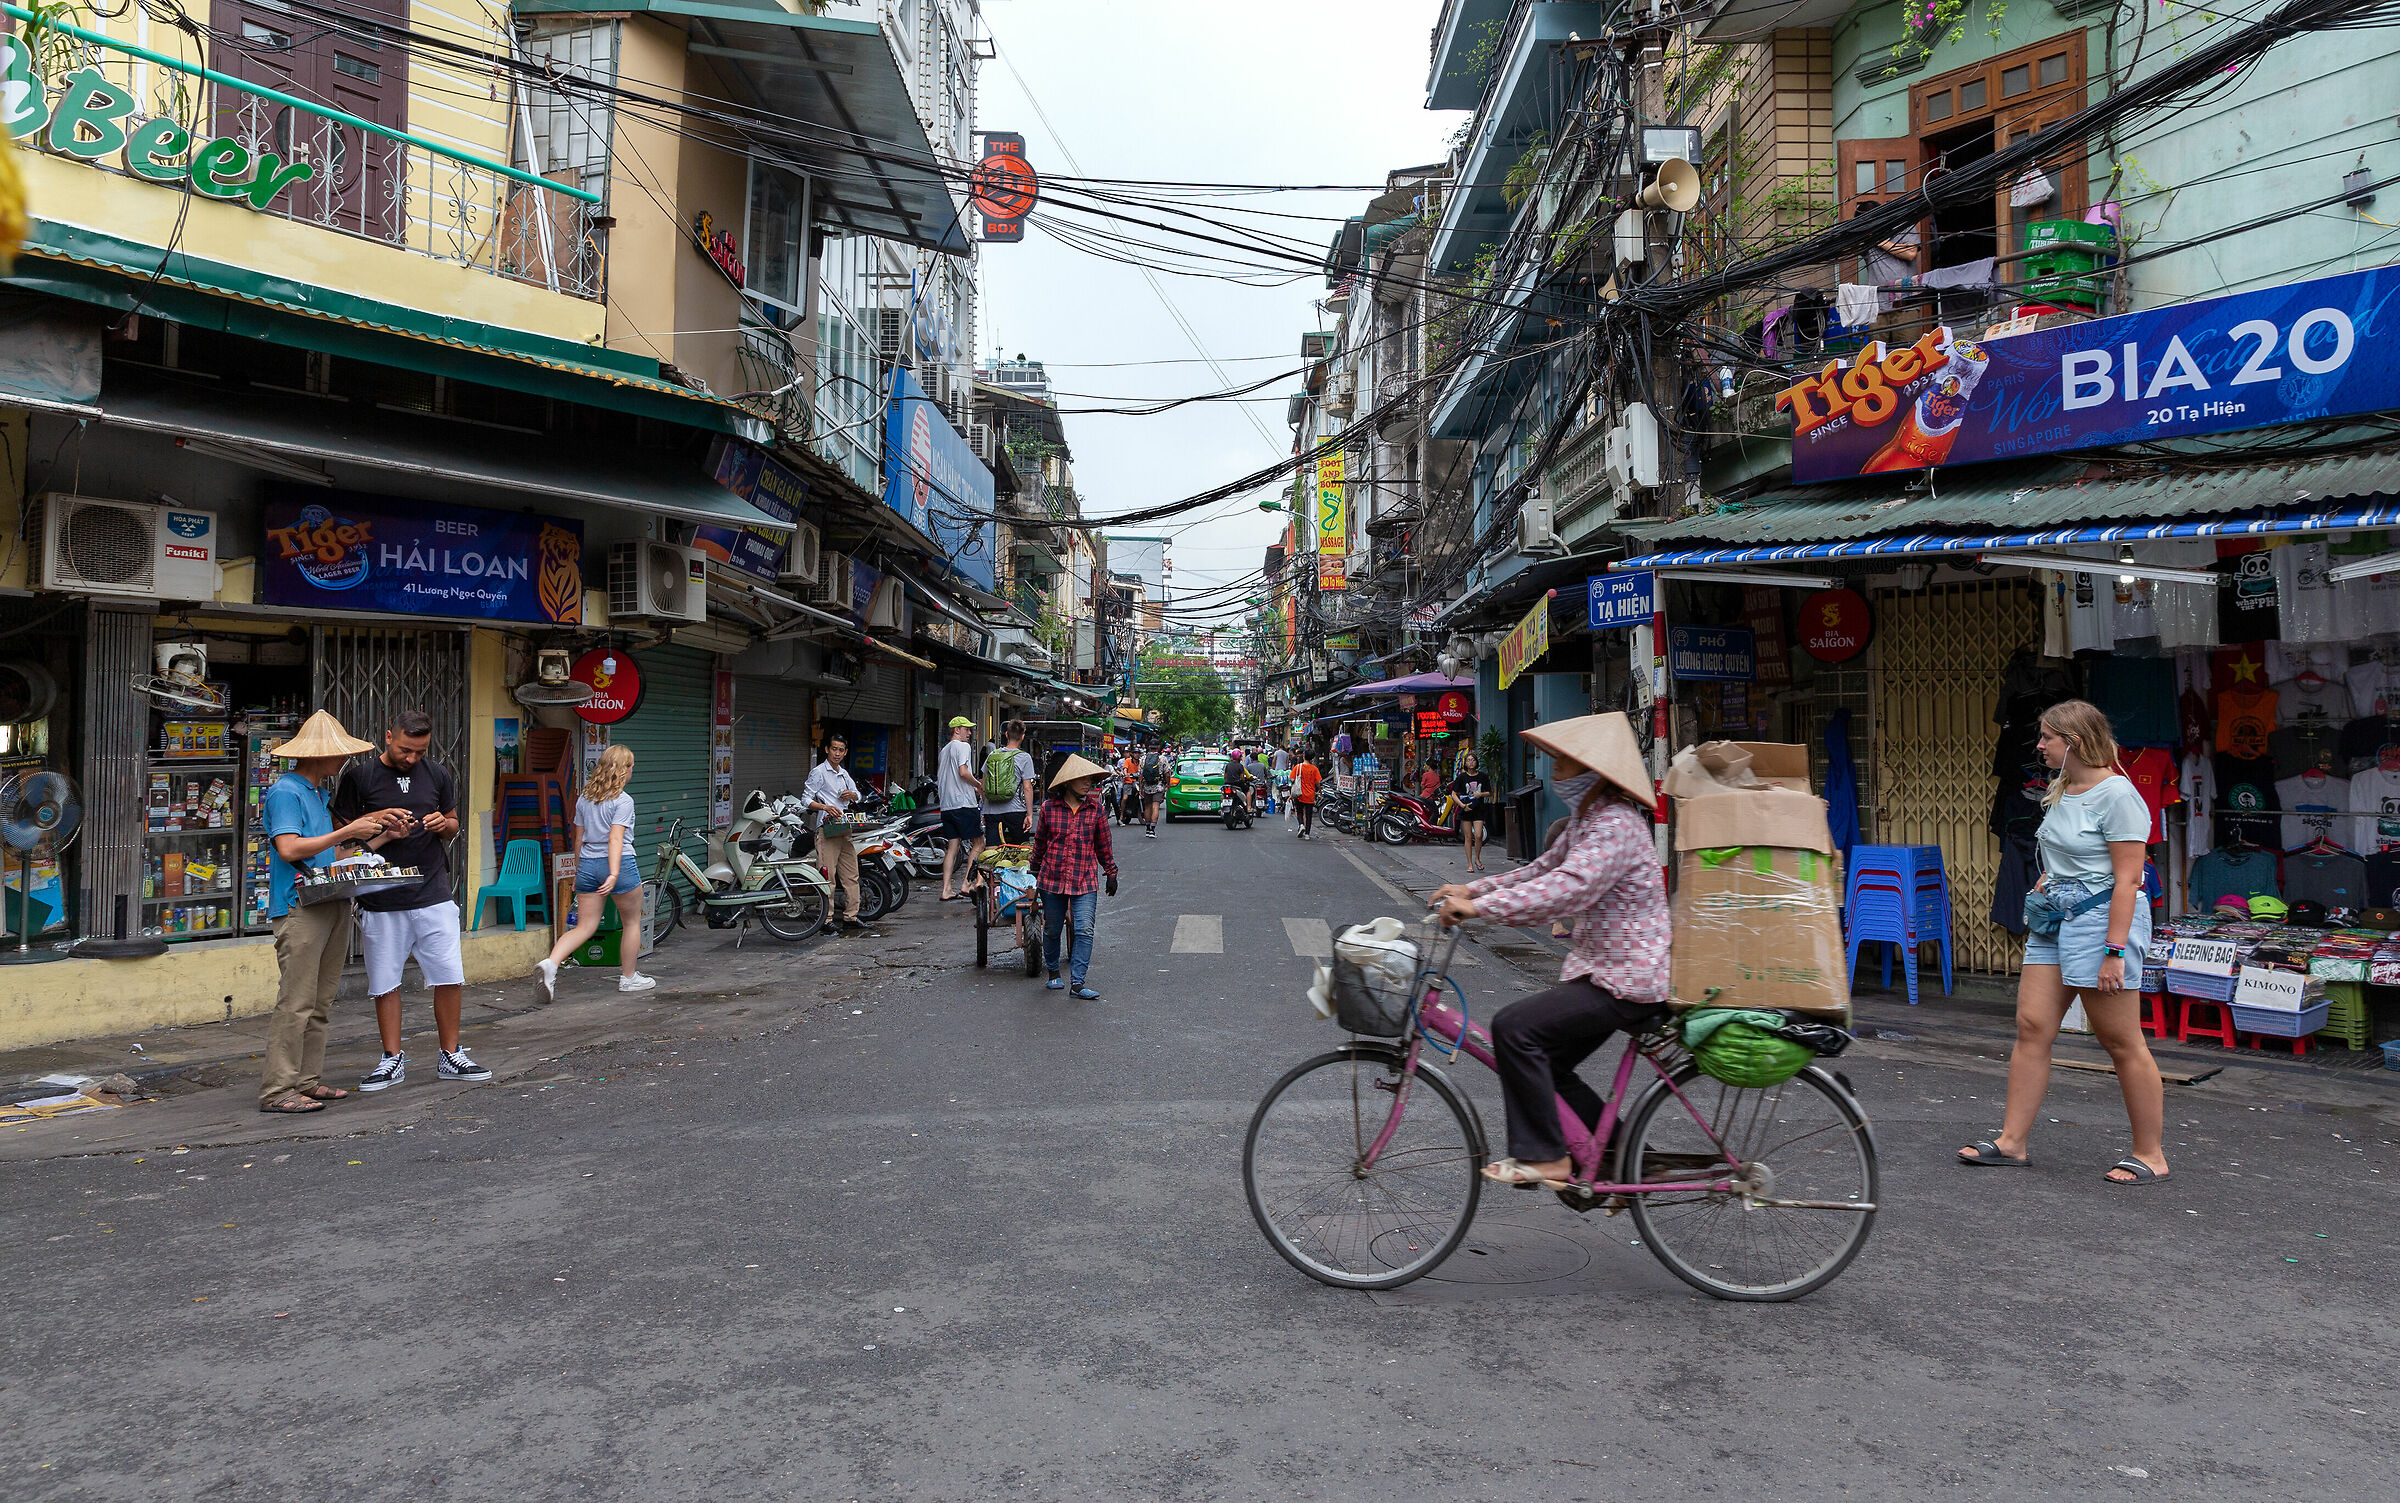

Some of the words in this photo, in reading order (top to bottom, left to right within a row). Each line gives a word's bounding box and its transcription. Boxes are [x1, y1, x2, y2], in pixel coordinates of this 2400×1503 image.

[47, 66, 314, 212] Beer
[990, 140, 1019, 153] THE
[987, 222, 1018, 234] BOX
[2061, 334, 2212, 412] BIA
[2228, 306, 2355, 386] 20
[1775, 326, 1952, 436] Tiger
[1987, 371, 2025, 391] PARIS
[1810, 415, 1848, 440] SINCE
[1903, 372, 1937, 396] 1932
[1925, 391, 1960, 418] Tiger
[2147, 408, 2173, 425] 20
[2176, 404, 2200, 422] Tạ
[2203, 400, 2246, 418] Hiện
[1993, 423, 2072, 456] SINGAPORE
[1322, 470, 1340, 478] AND
[187, 515, 205, 525] PHÁT
[435, 519, 479, 537] BEER
[266, 518, 375, 563] Tiger
[1320, 537, 1344, 548] MASSAGE
[165, 547, 206, 559] Funiki
[290, 553, 315, 564] SINCE
[380, 538, 434, 572] HẢI
[444, 550, 528, 581] LOAN
[317, 570, 342, 580] LAGER
[343, 566, 361, 576] BEER
[403, 583, 416, 593] 41
[418, 584, 449, 599] Lương
[450, 587, 475, 600] Ngọc
[1611, 577, 1635, 594] PHỐ
[1598, 600, 1614, 621] TẠ
[1617, 589, 1650, 619] HIỆN
[1699, 633, 1726, 647] PHỐ
[1810, 636, 1854, 648] SAIGON
[1825, 630, 1839, 638] BIA
[1675, 649, 1701, 671] LƯƠNG
[1702, 651, 1724, 675] NGỌC
[595, 691, 609, 699] BIA
[855, 731, 876, 769] BIA
[2175, 943, 2214, 963] SLEEPING
[2215, 945, 2233, 963] BAG
[2244, 978, 2296, 995] KIMONO
